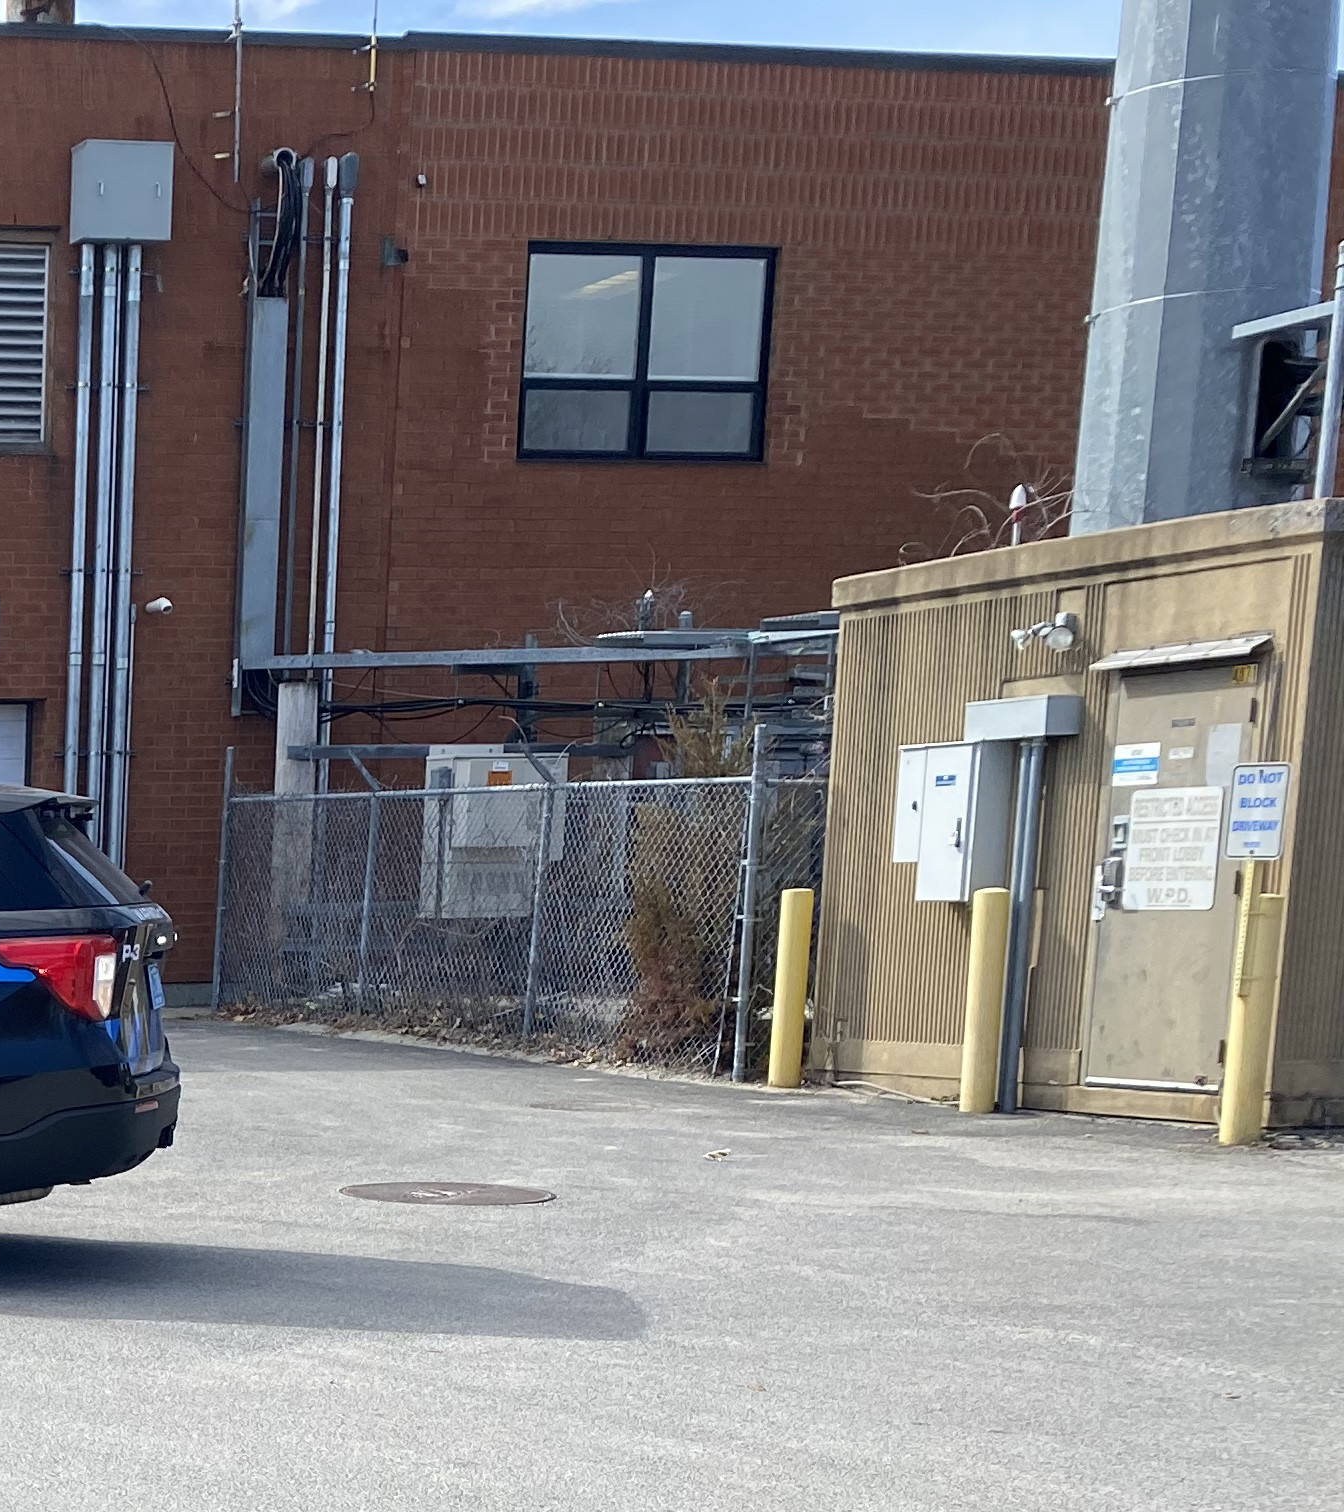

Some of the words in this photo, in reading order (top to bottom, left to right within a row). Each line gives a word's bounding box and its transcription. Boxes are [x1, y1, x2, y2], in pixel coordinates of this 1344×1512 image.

[1238, 774, 1255, 785] DO
[1259, 772, 1284, 784] NOT
[1240, 797, 1277, 809] BLOCK
[1232, 820, 1279, 832] DRIVEWAY
[1146, 887, 1192, 904] W.P.D.
